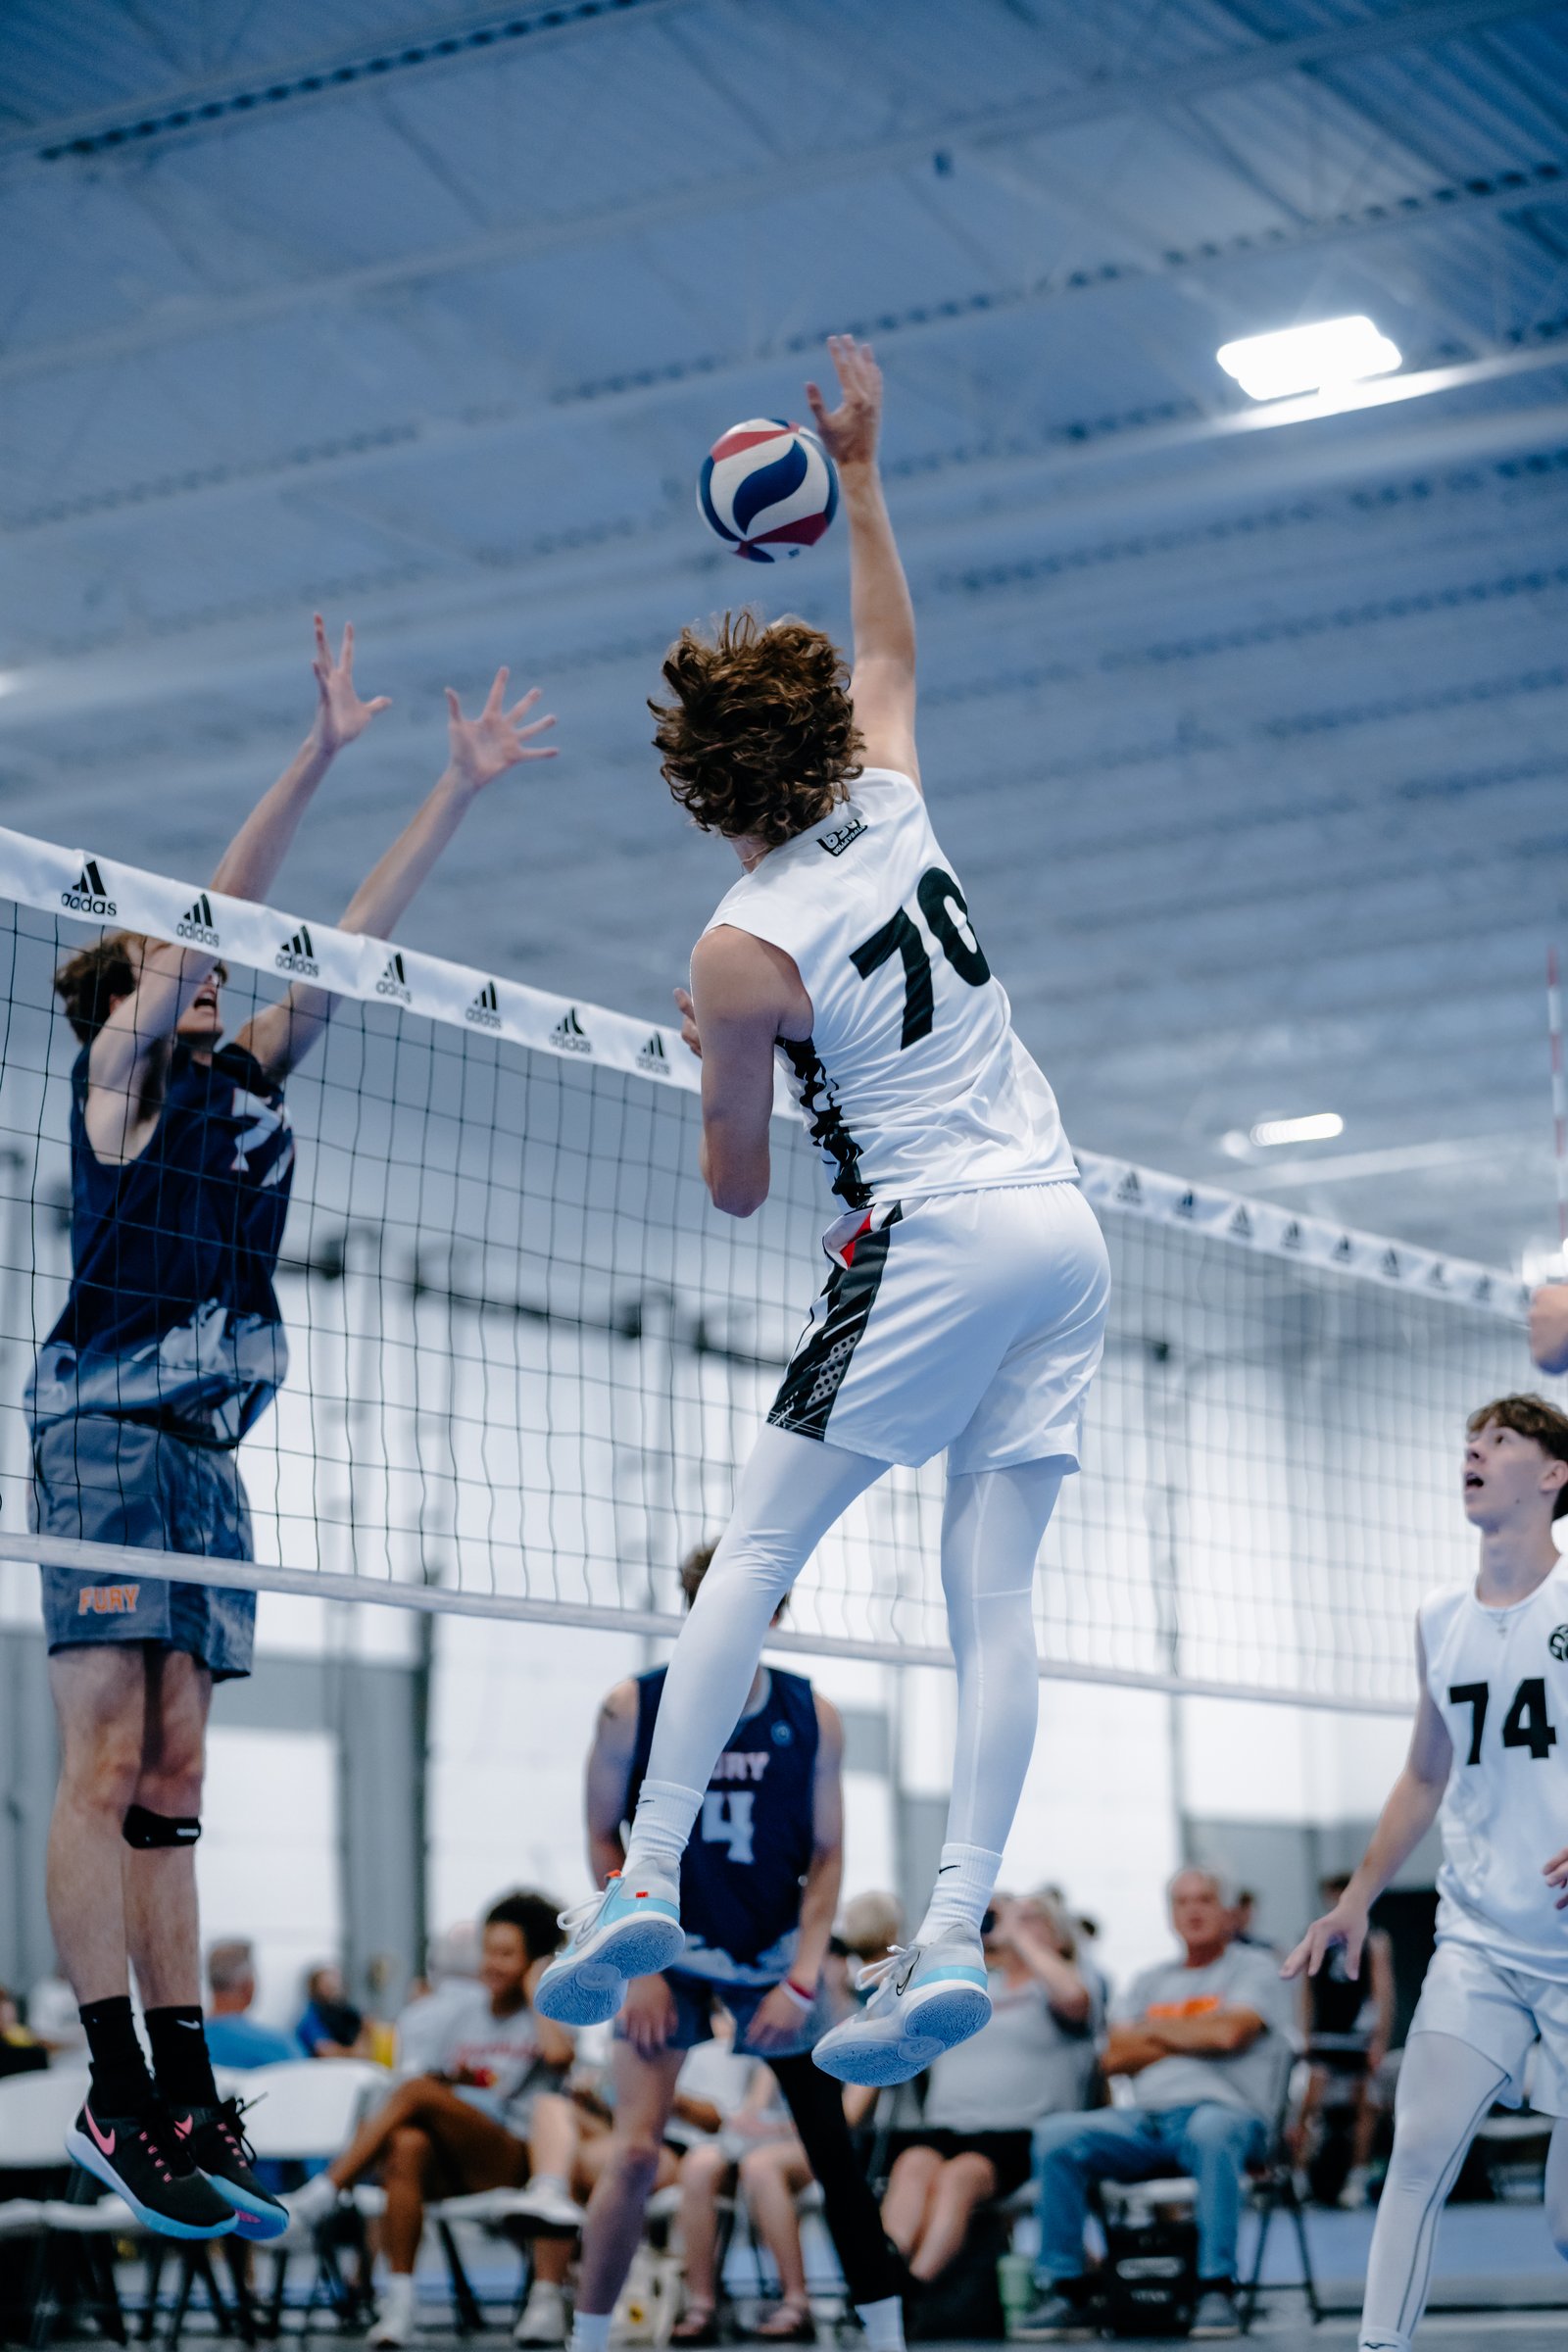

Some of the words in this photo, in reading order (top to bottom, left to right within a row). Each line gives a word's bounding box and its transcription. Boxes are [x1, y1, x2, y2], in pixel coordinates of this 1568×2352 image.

[61, 893, 118, 916] addas
[176, 922, 220, 948] adidas
[275, 954, 318, 978] adidas
[849, 866, 991, 1051] 70
[466, 1006, 502, 1029] adidas
[77, 1583, 140, 1616] FURY
[1448, 1677, 1557, 1765] 74
[702, 1790, 756, 1864] 4
